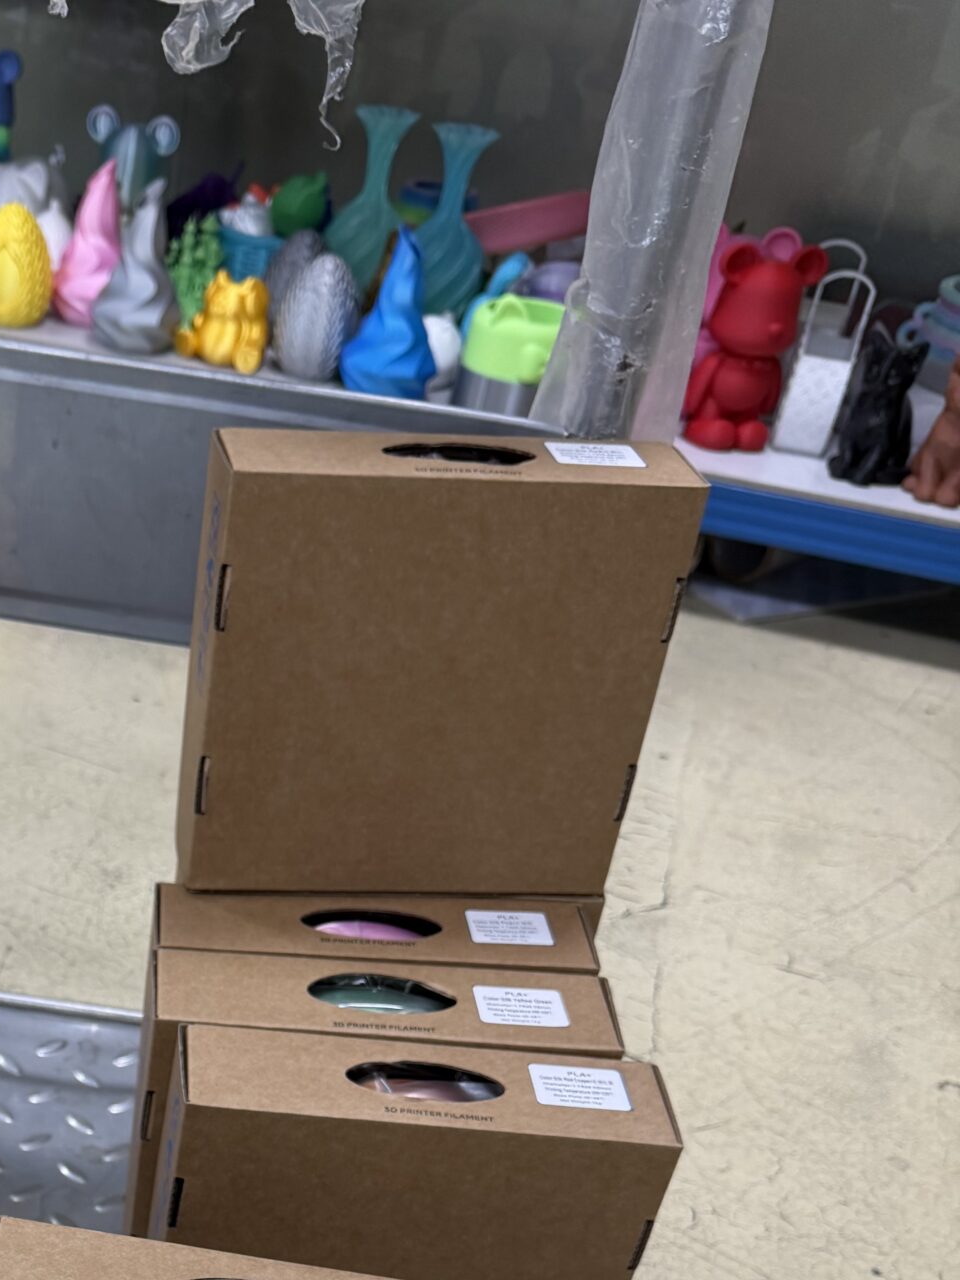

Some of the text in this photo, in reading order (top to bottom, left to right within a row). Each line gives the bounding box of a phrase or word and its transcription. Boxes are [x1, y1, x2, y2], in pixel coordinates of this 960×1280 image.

[388, 1024, 436, 1033] FILAMENT
[384, 1106, 494, 1123] 3D PRINTER FILAMENT
